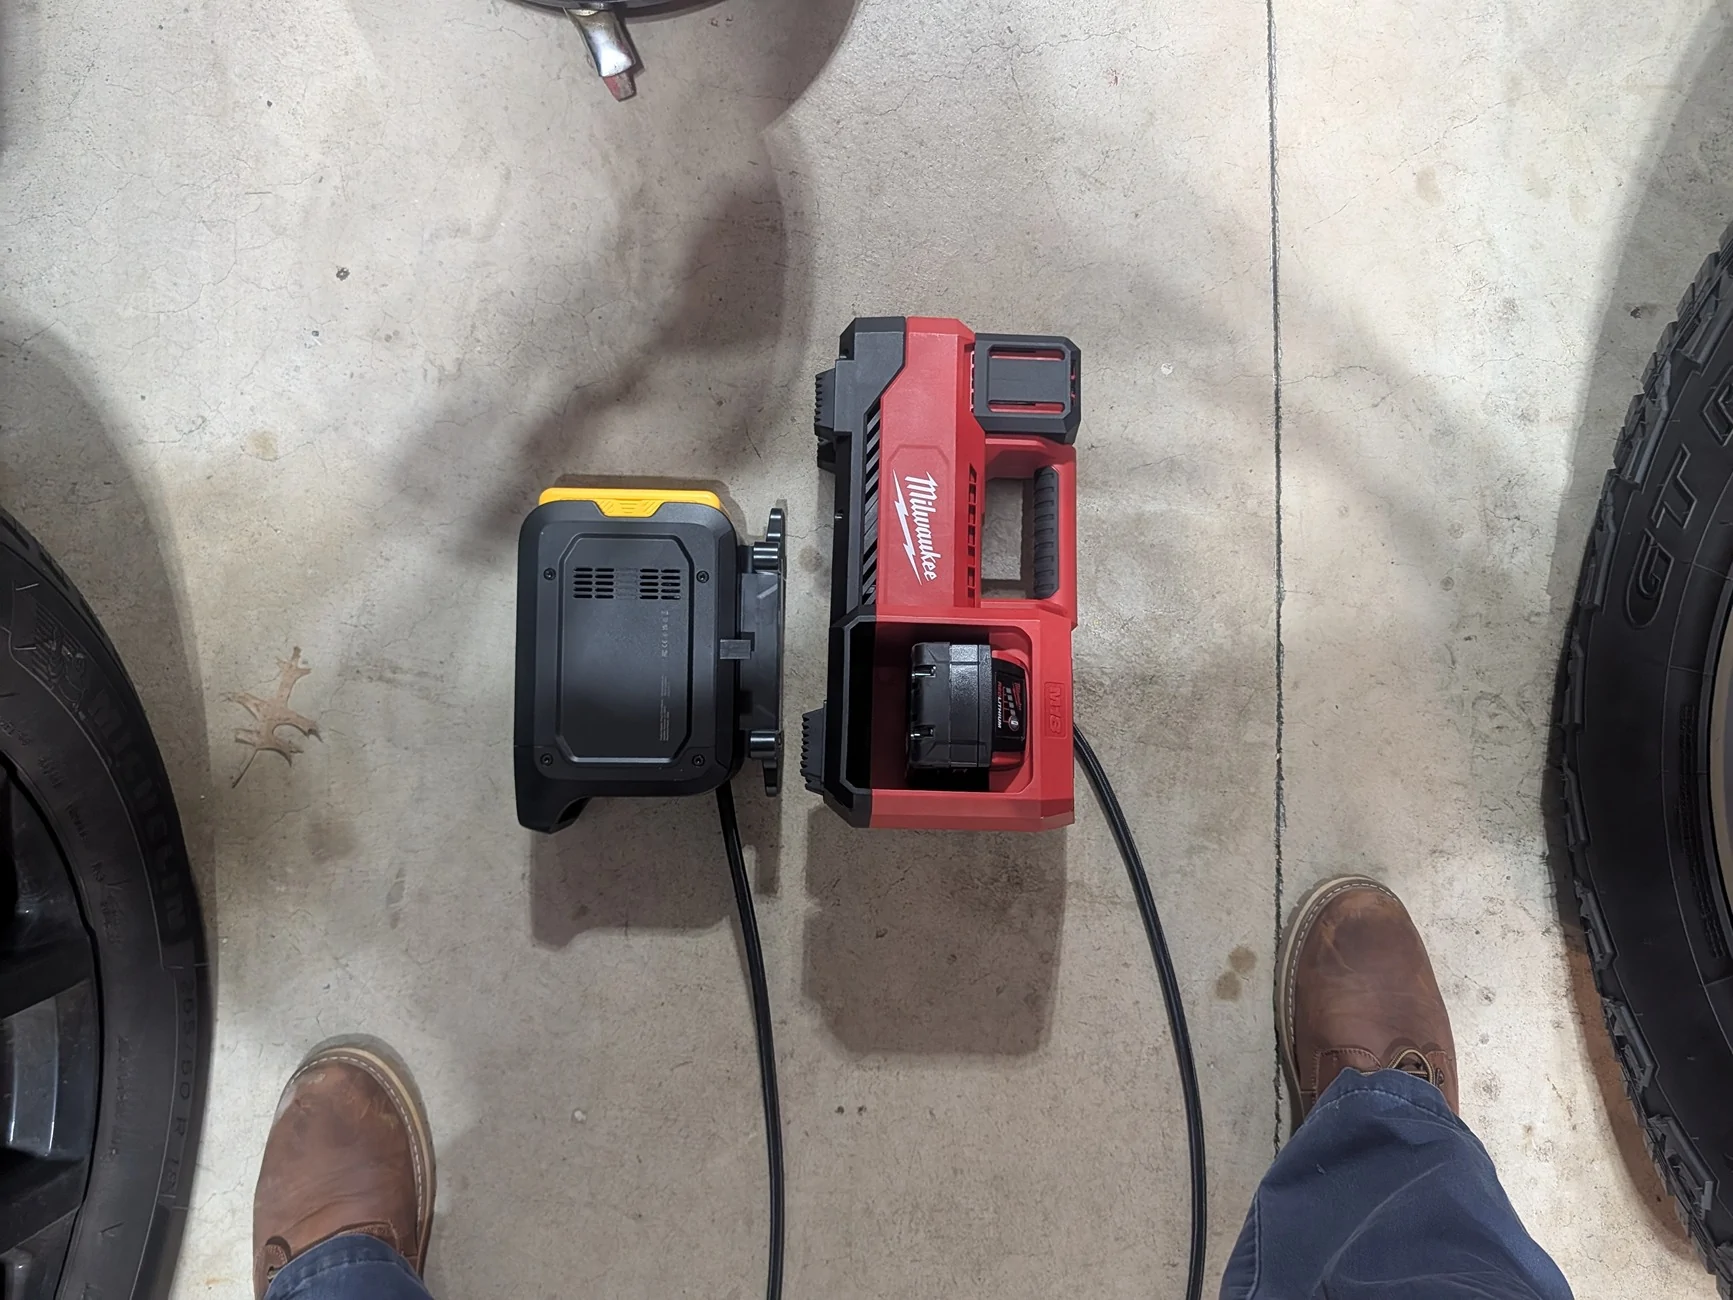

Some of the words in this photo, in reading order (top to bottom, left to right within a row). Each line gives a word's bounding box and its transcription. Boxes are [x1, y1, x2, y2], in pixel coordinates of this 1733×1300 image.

[904, 470, 942, 582] Milwaukee
[1626, 443, 1698, 629] GT
[1048, 686, 1062, 735] M18
[88, 687, 187, 930] MICHELIN
